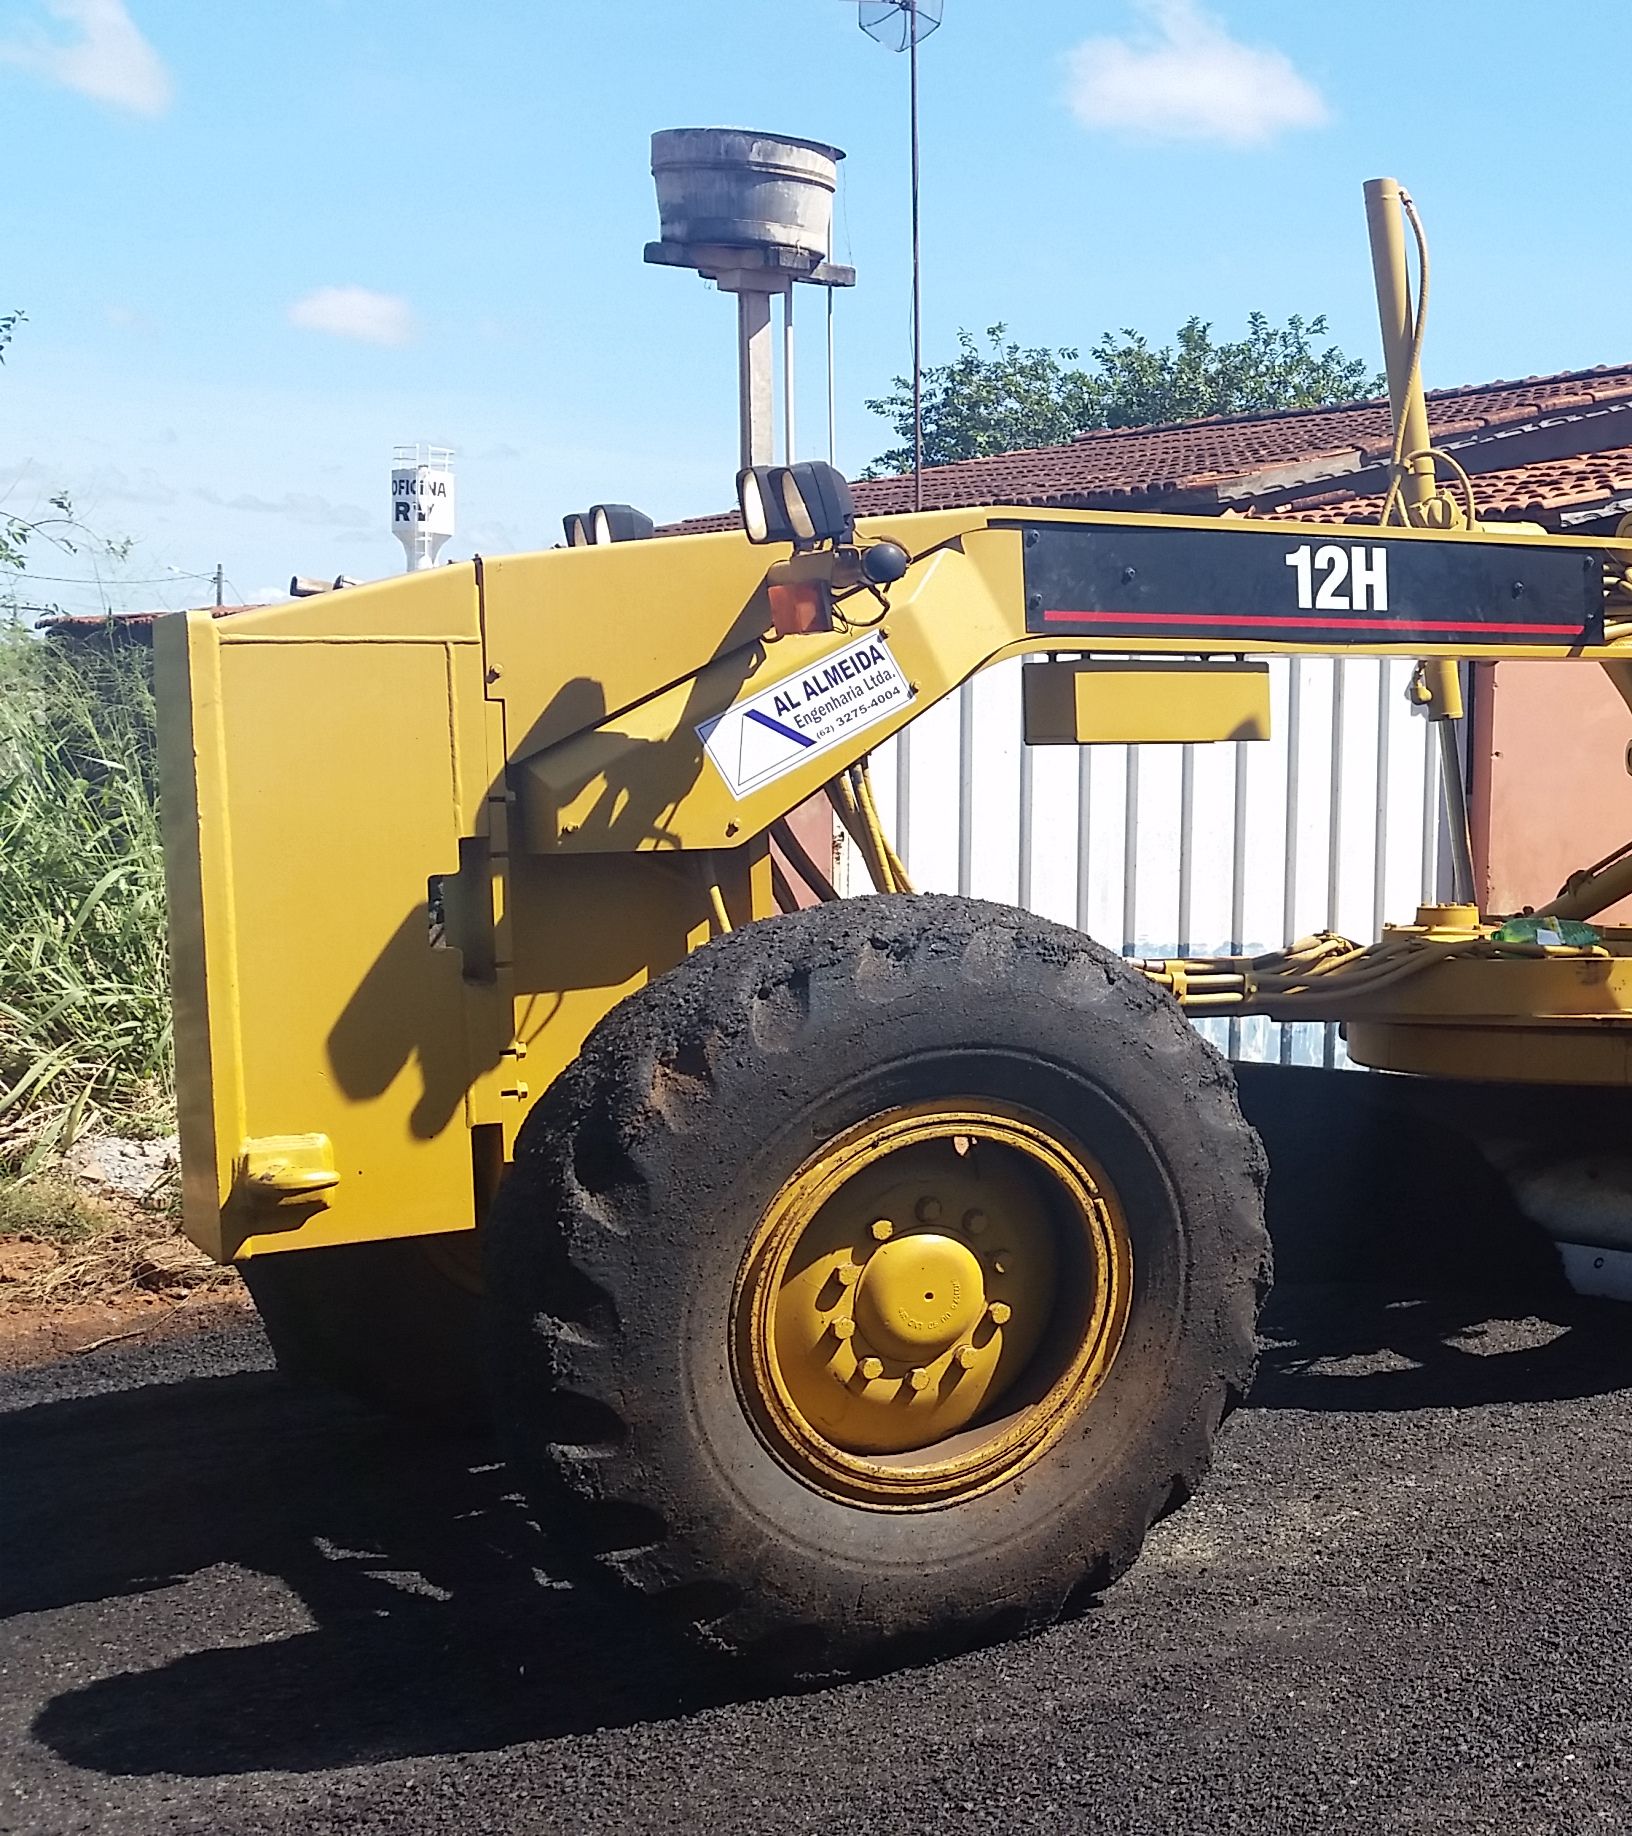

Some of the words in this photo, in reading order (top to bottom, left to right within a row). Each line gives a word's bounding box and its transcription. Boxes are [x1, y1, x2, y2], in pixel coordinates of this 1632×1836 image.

[1285, 544, 1388, 611] 12H
[773, 690, 801, 717] AL
[802, 644, 886, 702] ALMEIDA
[793, 685, 864, 729] Engenharia
[862, 670, 896, 691] Ltda.
[816, 725, 835, 740] (62)
[835, 686, 901, 727] 3275-4004
